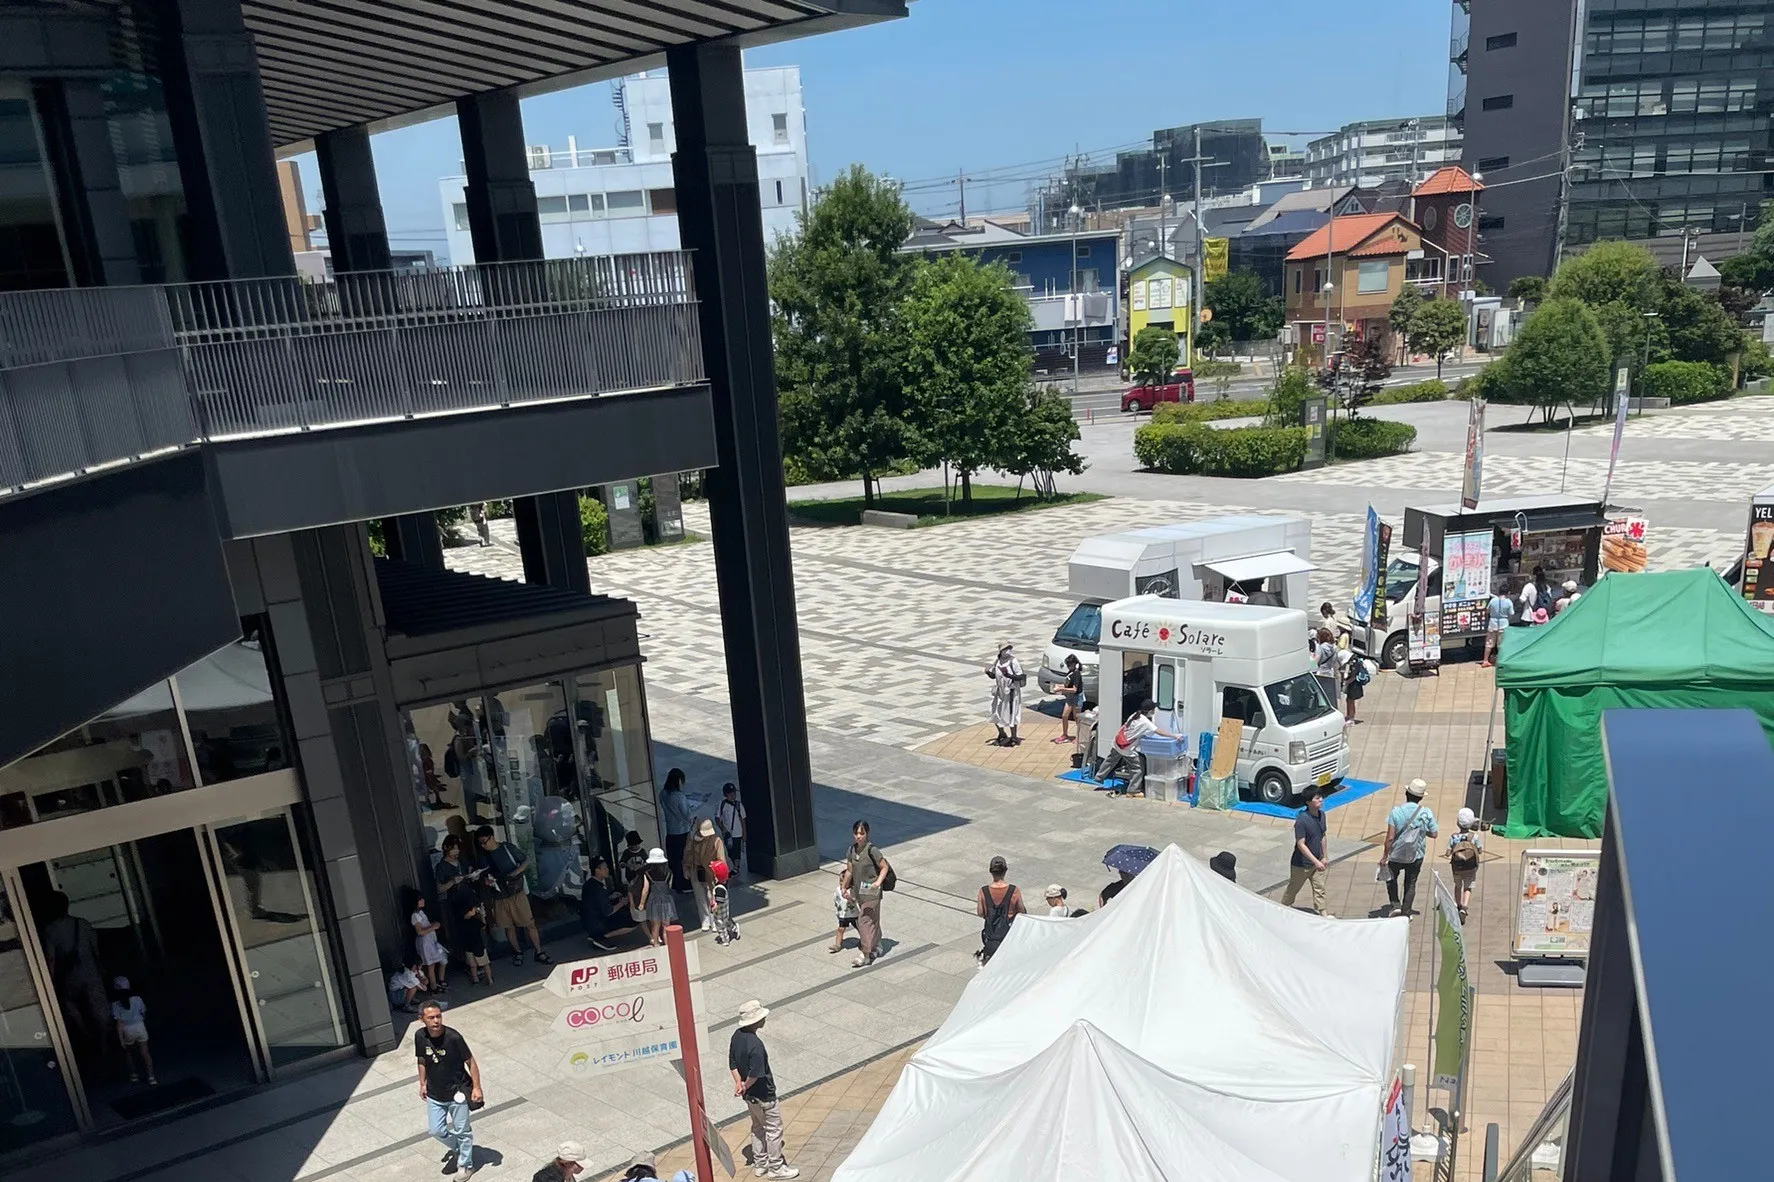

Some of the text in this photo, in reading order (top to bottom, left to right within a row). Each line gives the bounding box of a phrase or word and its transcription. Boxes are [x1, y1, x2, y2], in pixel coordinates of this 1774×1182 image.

[1111, 619, 1225, 646] Café Solare
[607, 958, 658, 981] 郵便局
[570, 982, 598, 992] POST
